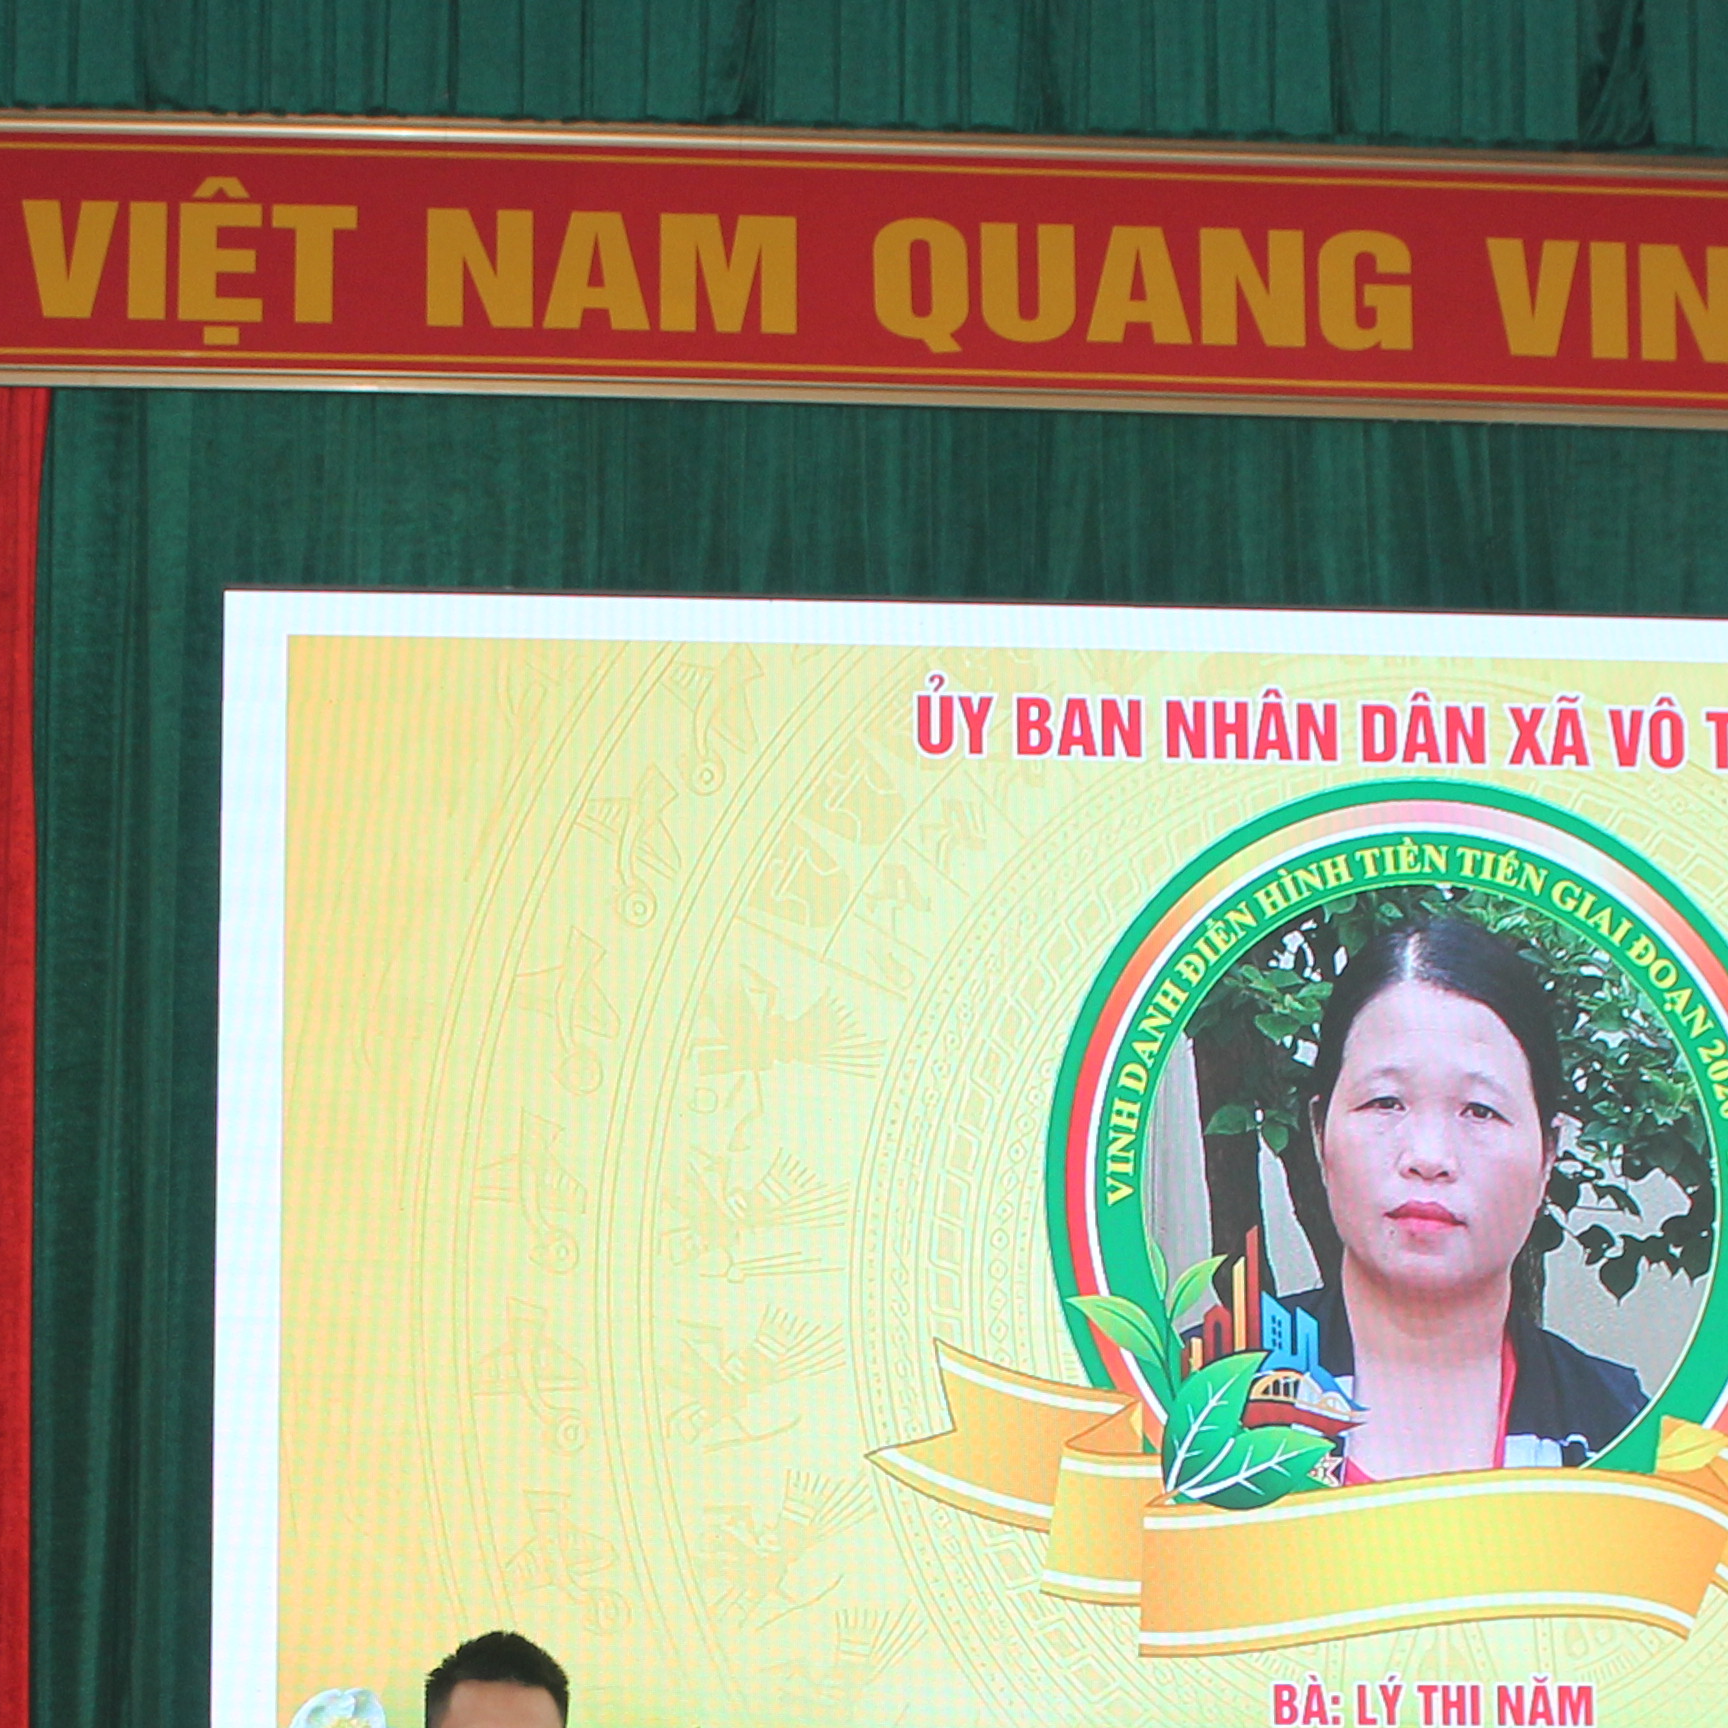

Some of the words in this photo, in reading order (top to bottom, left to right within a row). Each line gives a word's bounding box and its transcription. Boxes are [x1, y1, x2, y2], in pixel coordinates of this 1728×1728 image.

[23, 178, 357, 345] VIỆT
[427, 209, 796, 334] NAM
[873, 218, 1413, 354] QUANG
[917, 673, 993, 756] ỦY
[1017, 697, 1142, 758] BAN
[1167, 689, 1337, 762] NHÂN
[1362, 692, 1485, 764] DÂN
[1510, 695, 1589, 767] XÃ
[1608, 697, 1684, 769] VÔ
[1253, 854, 1354, 920] HÌNH
[1355, 836, 1449, 879] TIỀN
[1456, 849, 1548, 897] TIẾN
[1174, 901, 1258, 988] ĐIỂN
[1550, 880, 1633, 948] GIAI
[1625, 932, 1714, 1040] ĐOẠN
[1117, 979, 1191, 1095] DANH
[1106, 1097, 1142, 1206] VINH
[1272, 1675, 1342, 1726] BÀ:
[1357, 1676, 1403, 1726] LÝ
[1498, 1676, 1594, 1727] NĂM
